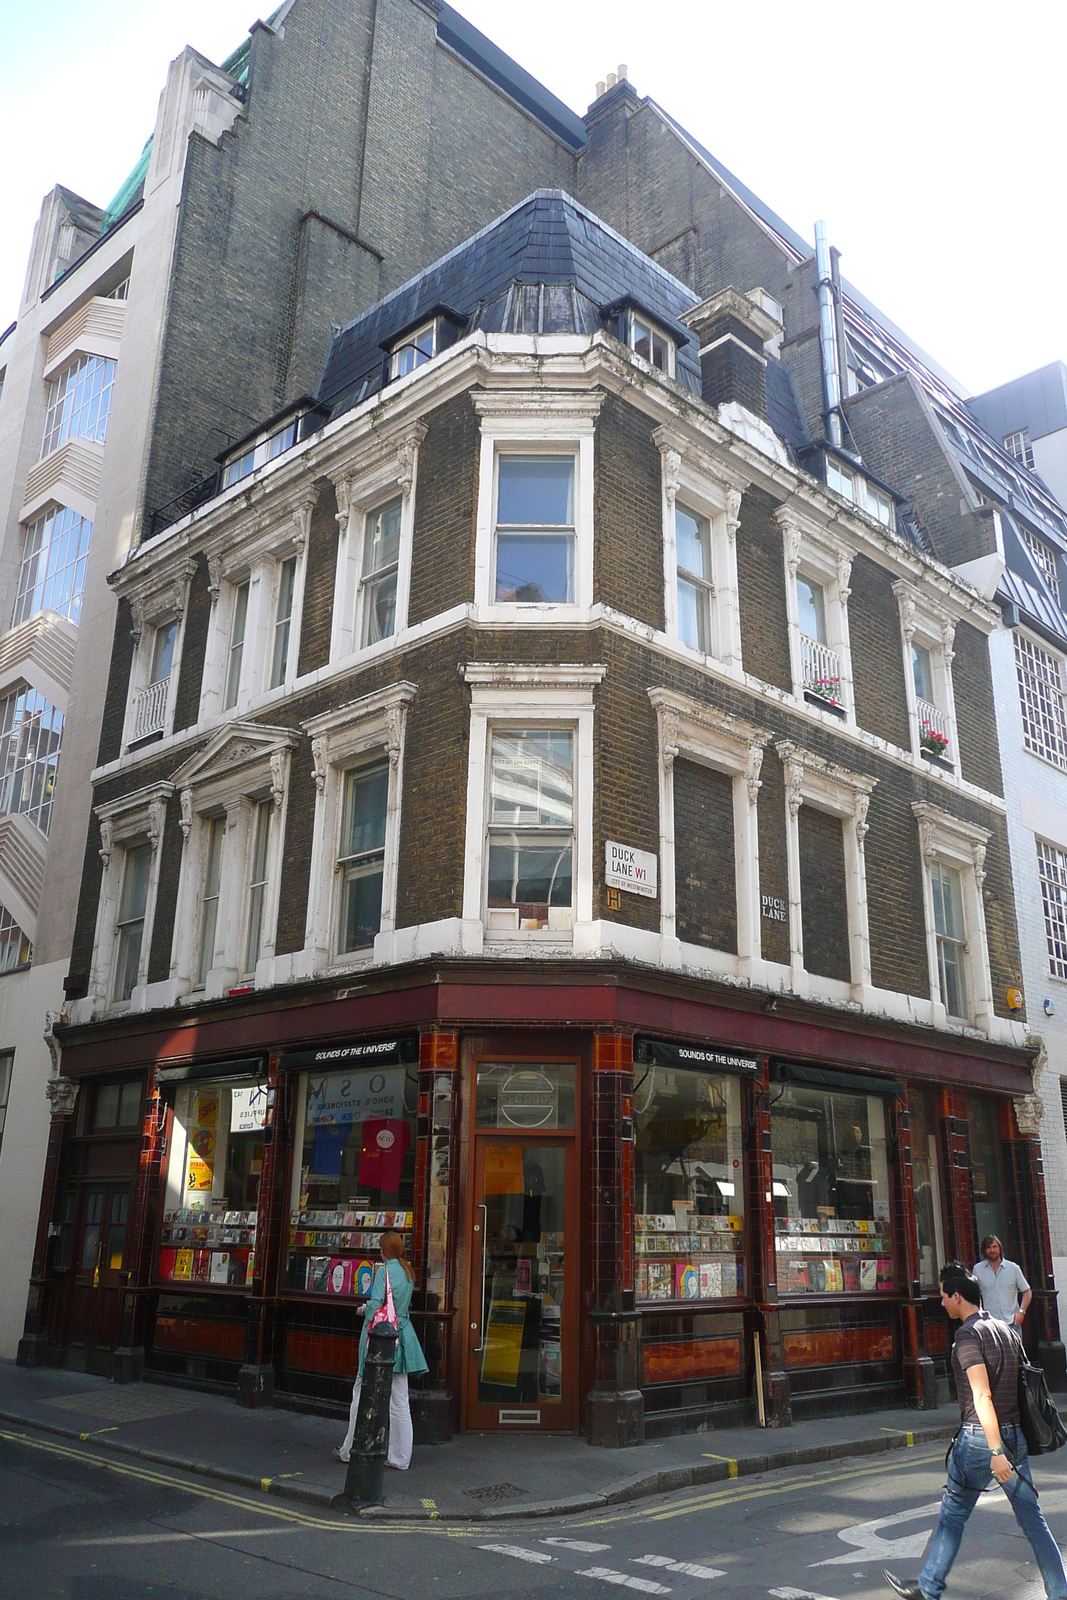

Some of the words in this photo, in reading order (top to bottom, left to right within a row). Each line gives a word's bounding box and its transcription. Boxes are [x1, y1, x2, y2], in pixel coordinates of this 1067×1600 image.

[612, 847, 635, 864] DUCK
[612, 860, 632, 877] LANE
[635, 867, 646, 881] W1
[612, 878, 620, 886] CITY
[627, 882, 652, 894] WESTMINSTER
[762, 895, 785, 911] DUCK
[762, 906, 786, 921] LANE
[315, 1050, 341, 1060] SOUNDS
[341, 1048, 350, 1057] OF
[350, 1047, 363, 1056] THE
[362, 1042, 397, 1055] UNIVERSE
[679, 1049, 705, 1060] SOUNDS
[705, 1053, 715, 1062] OF
[715, 1054, 727, 1064] THE
[727, 1057, 757, 1069] UNIVERSE
